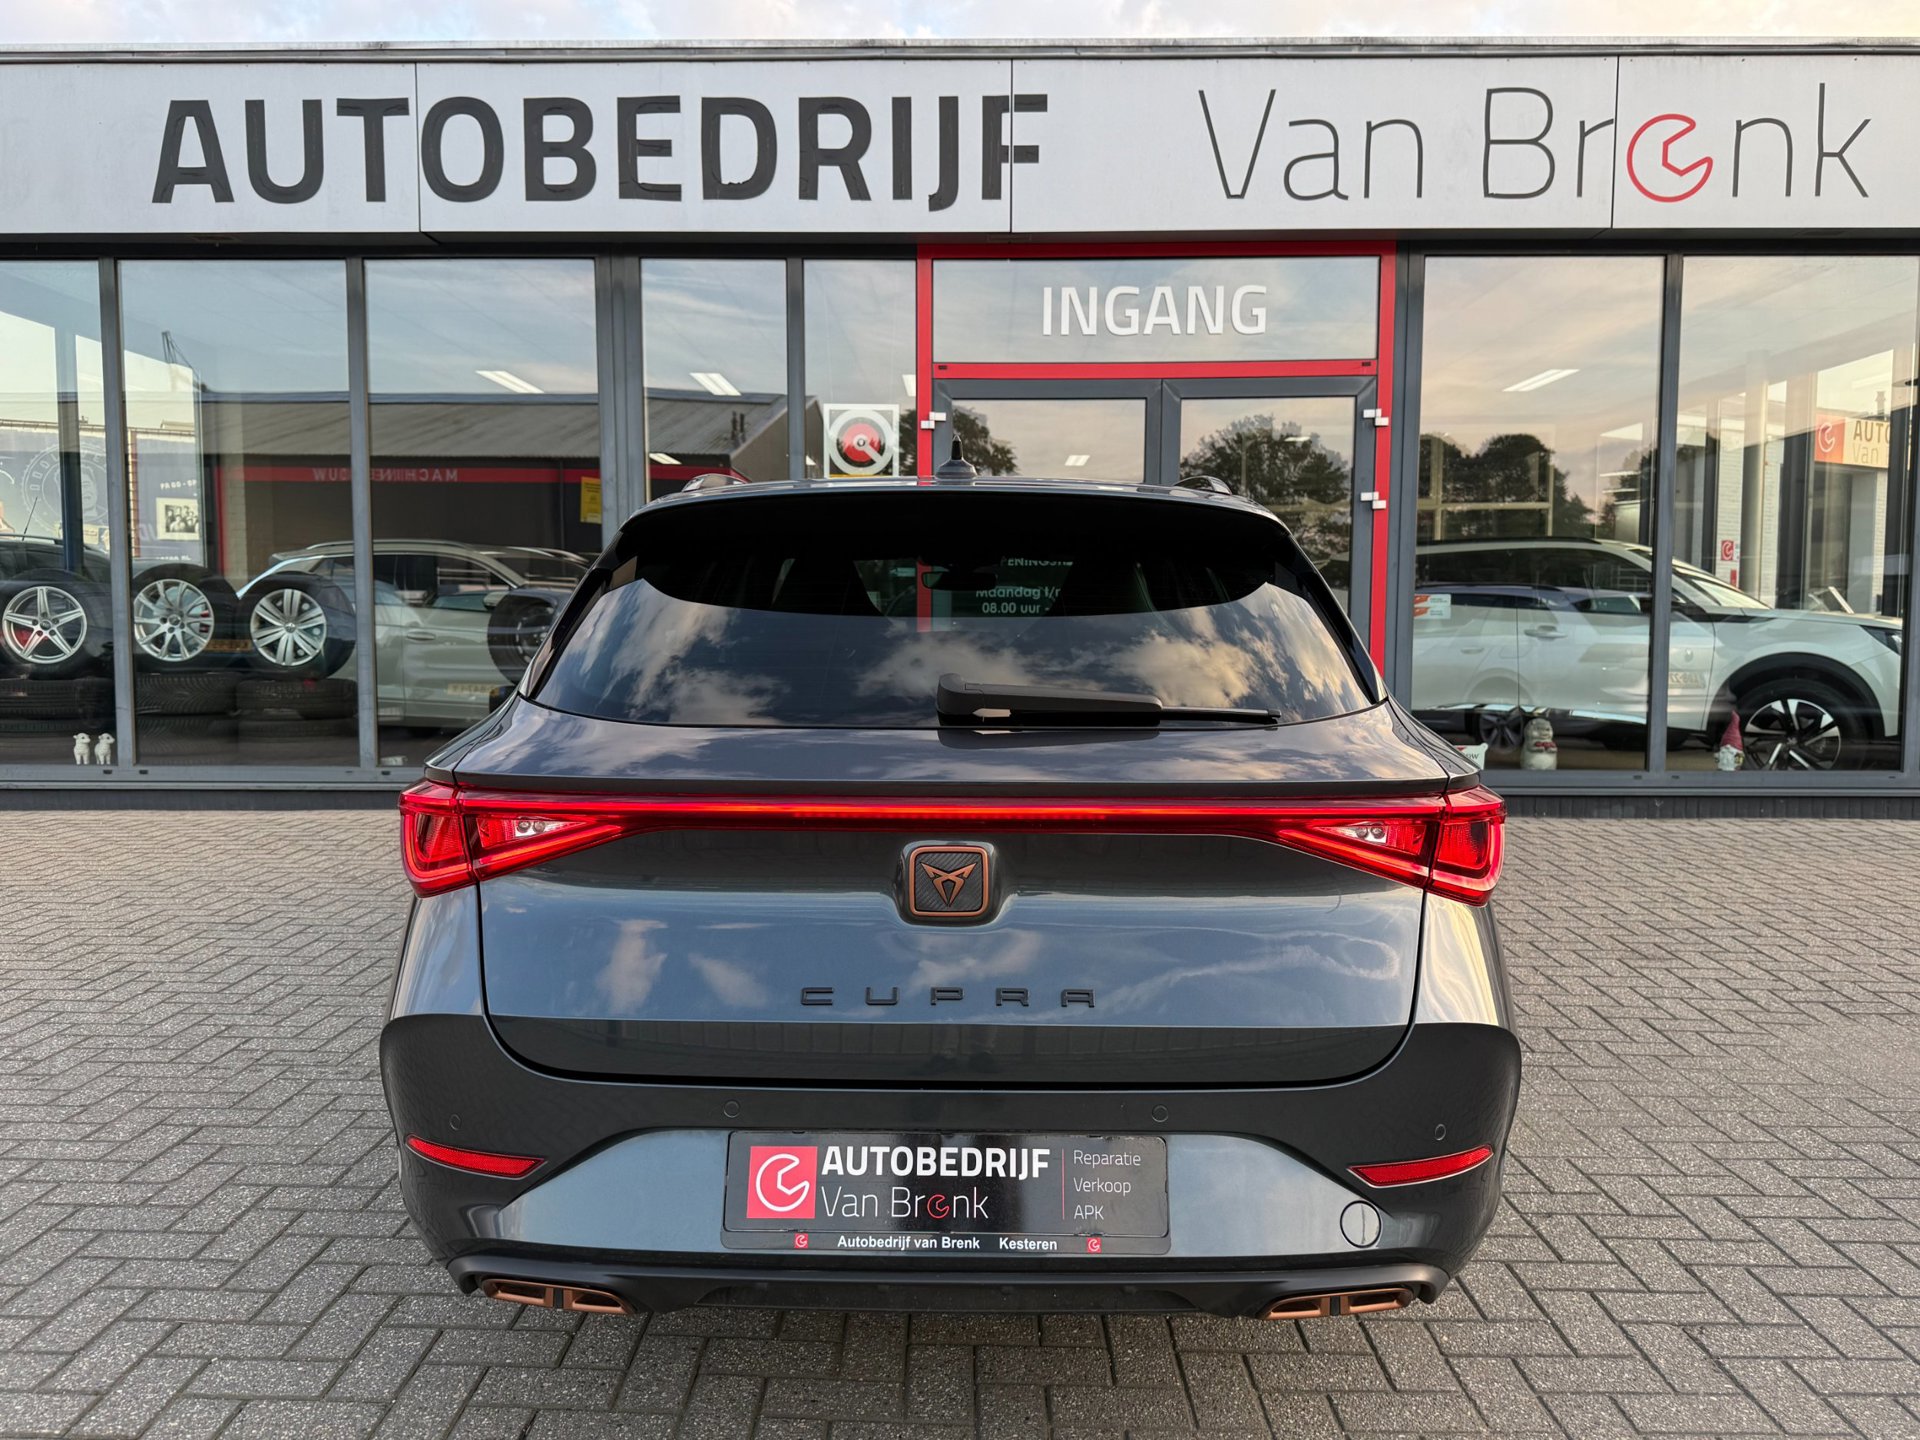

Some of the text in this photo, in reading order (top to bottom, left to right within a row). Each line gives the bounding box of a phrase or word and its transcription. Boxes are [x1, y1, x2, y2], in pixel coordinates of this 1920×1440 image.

[152, 82, 1871, 211] AUTOBEDRIJF Van Brenk
[1041, 284, 1268, 337] INGANG
[981, 602, 1017, 613] 08.00
[1020, 604, 1041, 613] uur
[800, 986, 1096, 1008] CUPRA
[821, 1145, 1050, 1181] AUTOBEDRIJF
[1073, 1149, 1142, 1169] Reparatie
[1073, 1178, 1132, 1196] Verkoop
[821, 1186, 989, 1219] Van Brenk
[1073, 1204, 1105, 1220] APK
[837, 1235, 1058, 1251] Autobedrijf van Brenk Kesteren
